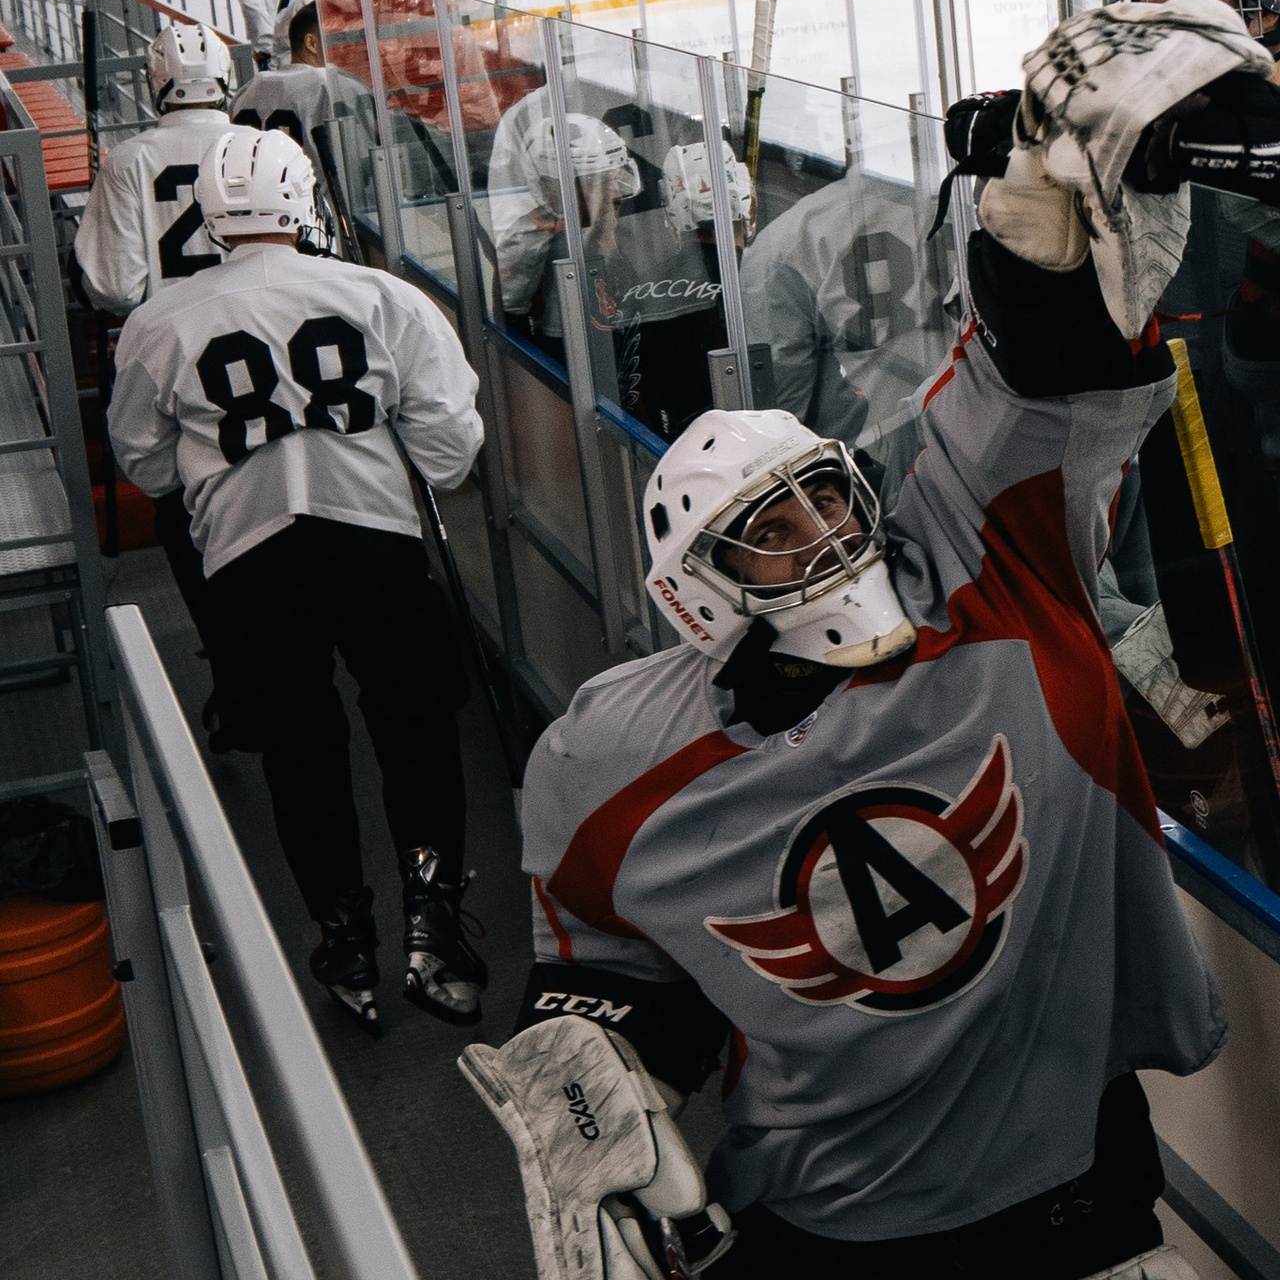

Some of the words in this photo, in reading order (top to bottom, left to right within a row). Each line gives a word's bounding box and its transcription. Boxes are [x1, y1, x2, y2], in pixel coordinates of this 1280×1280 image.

[622, 279, 721, 303] РОССИЯ
[196, 314, 378, 466] 88
[653, 578, 716, 643] FONBET
[807, 812, 973, 975] A
[533, 991, 635, 1023] CCM
